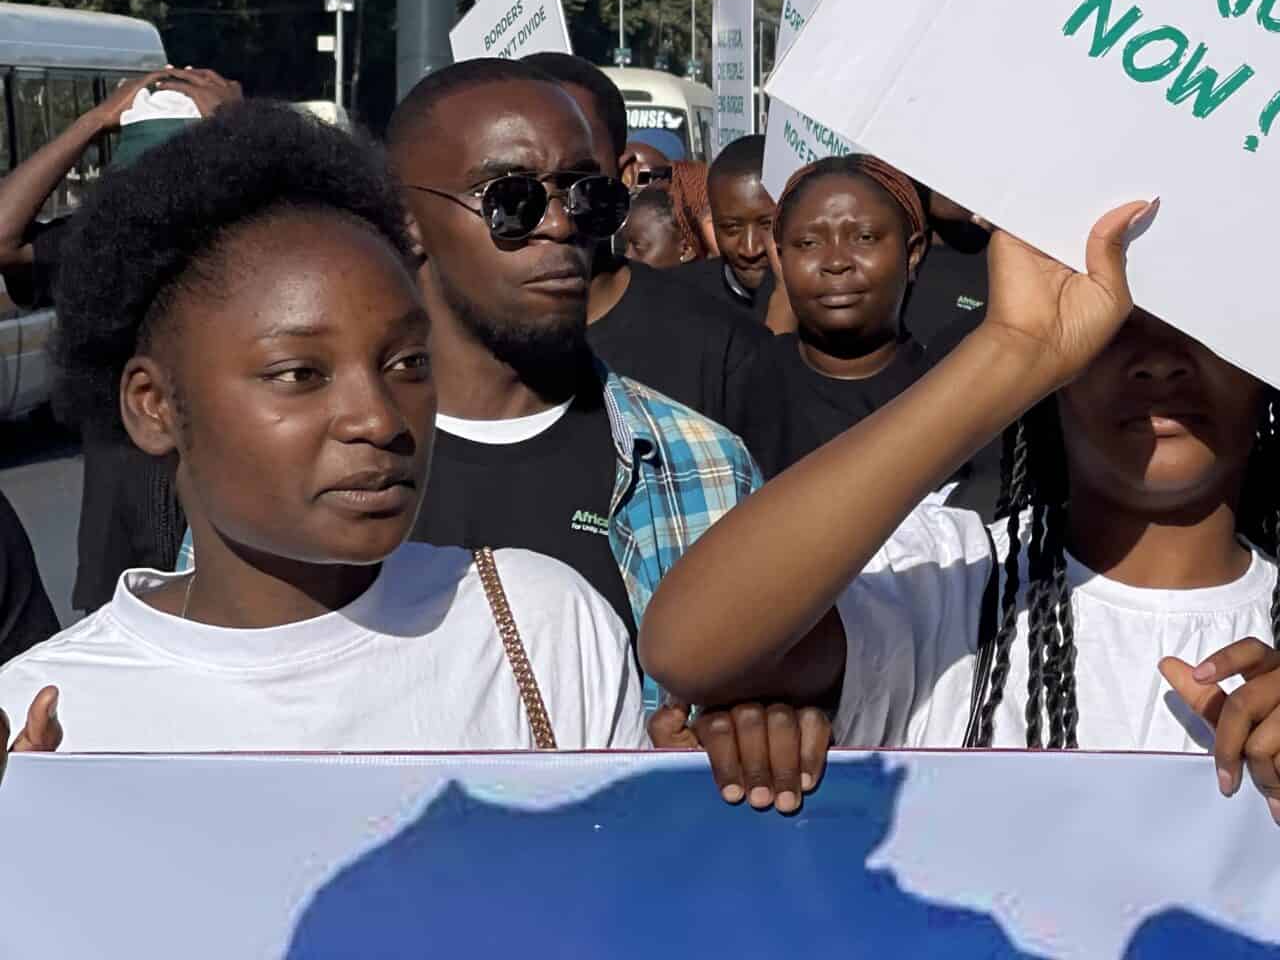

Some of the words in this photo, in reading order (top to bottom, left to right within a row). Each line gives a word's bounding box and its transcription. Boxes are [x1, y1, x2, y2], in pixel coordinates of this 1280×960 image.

[483, 0, 524, 51] BORDERS
[518, 5, 547, 46] DIVIDE
[784, 119, 807, 161] MOVE
